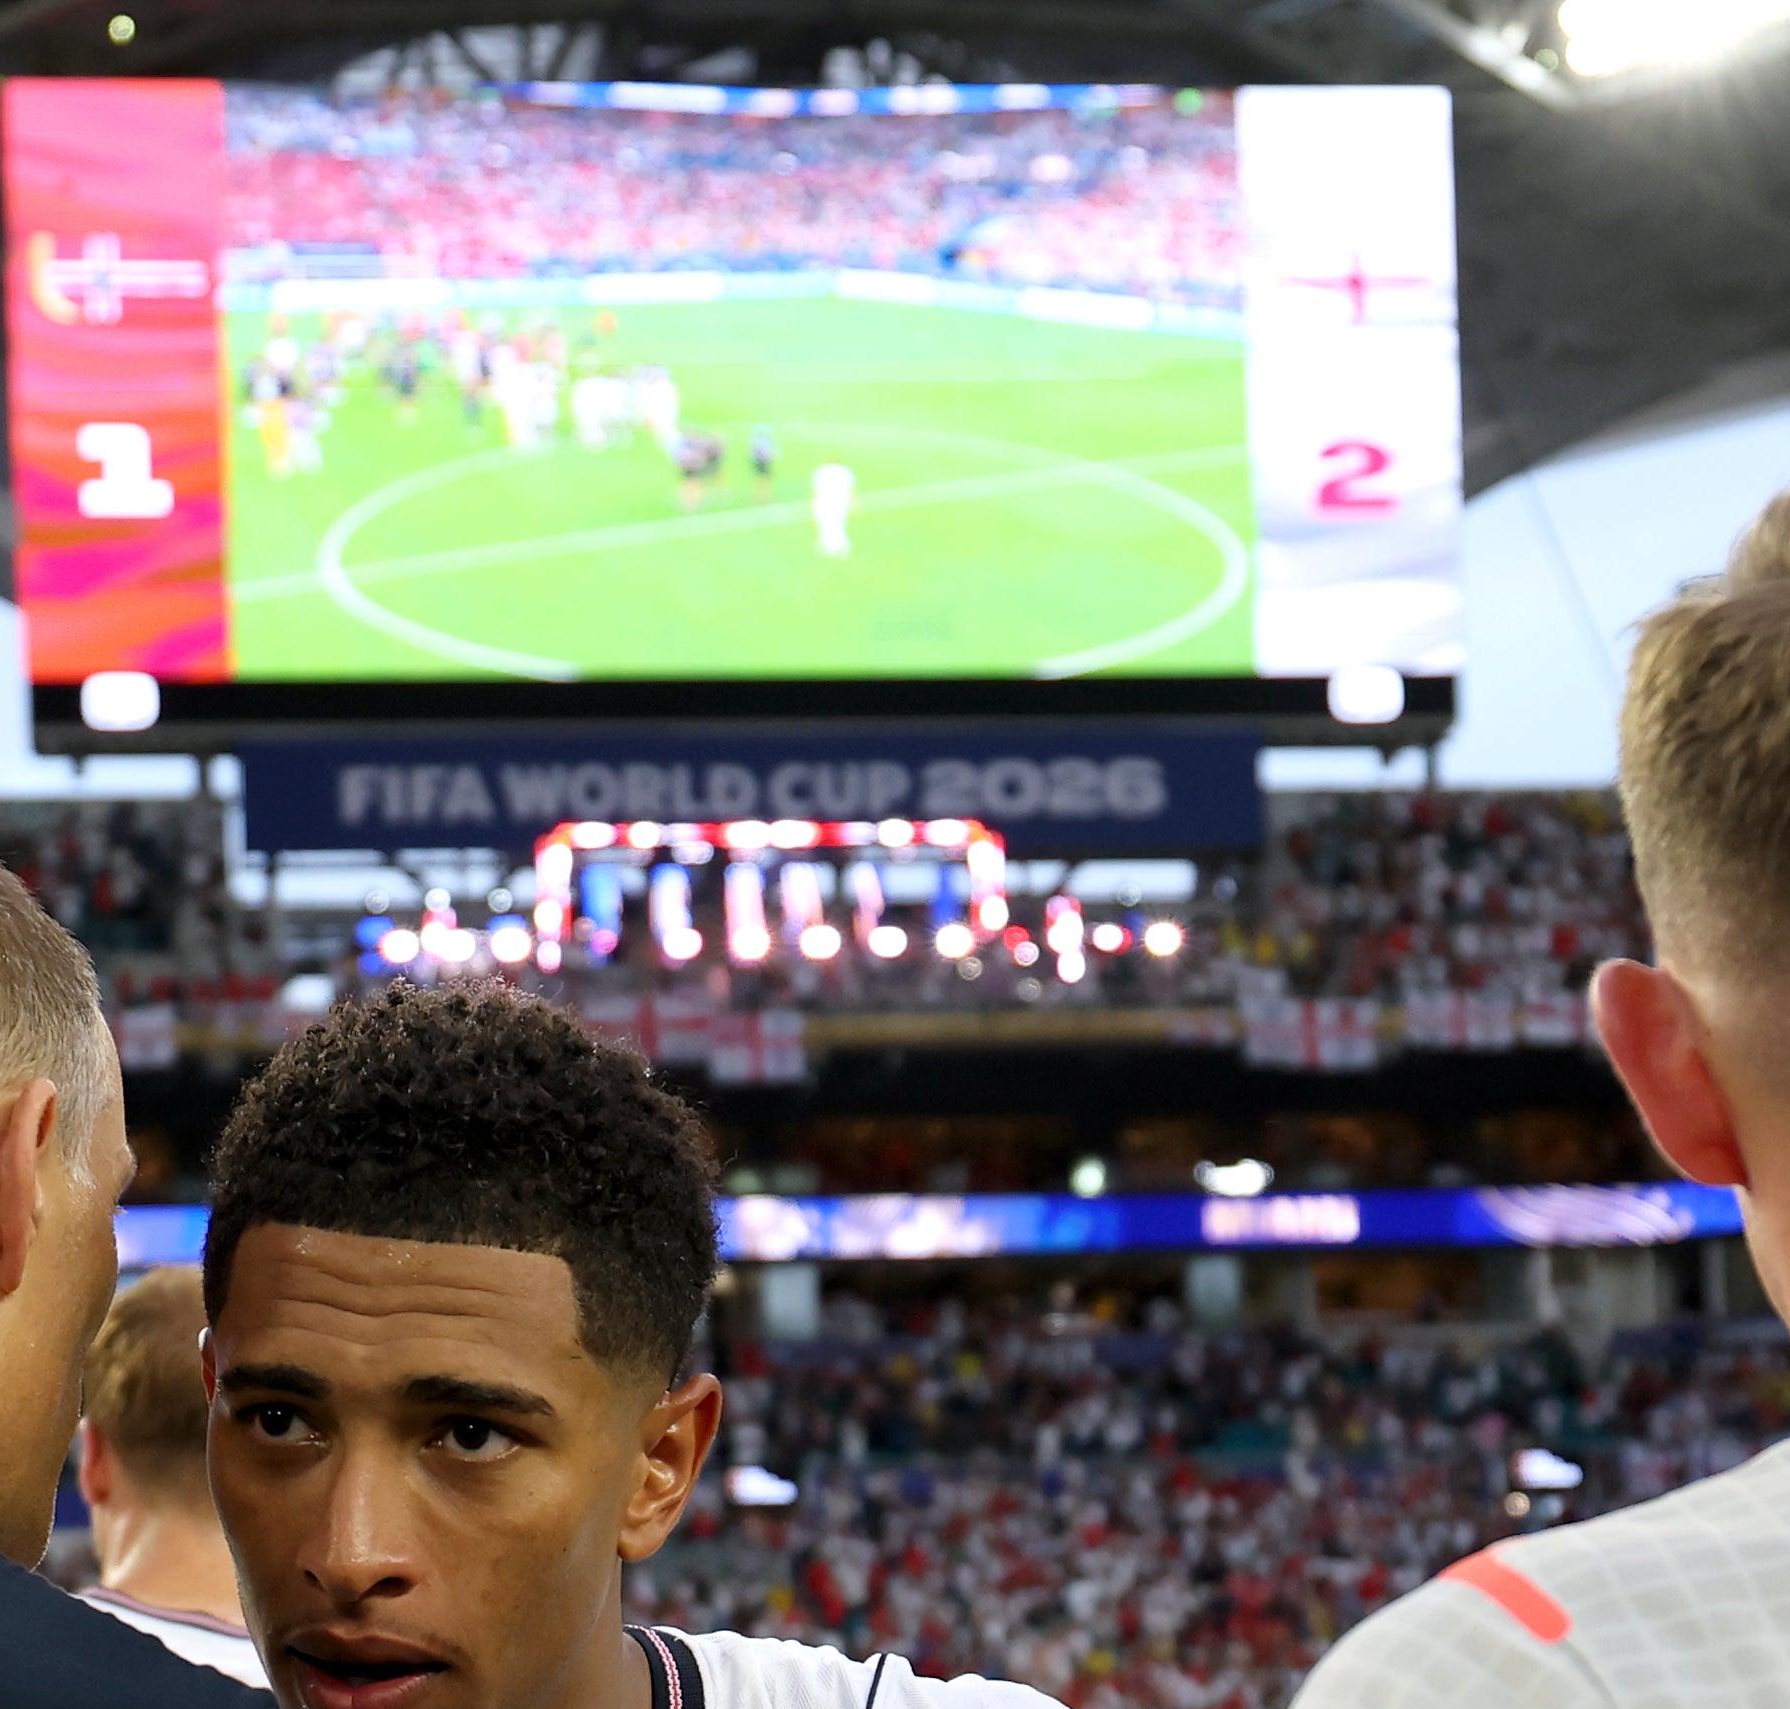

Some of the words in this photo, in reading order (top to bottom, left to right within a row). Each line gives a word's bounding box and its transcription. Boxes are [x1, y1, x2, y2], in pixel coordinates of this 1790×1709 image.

[76, 422, 175, 519] 1
[1313, 437, 1400, 517] 2
[338, 762, 498, 826] FIFA
[500, 762, 760, 821] WORLD
[767, 760, 912, 820] CUP
[921, 757, 1167, 820] 2026
